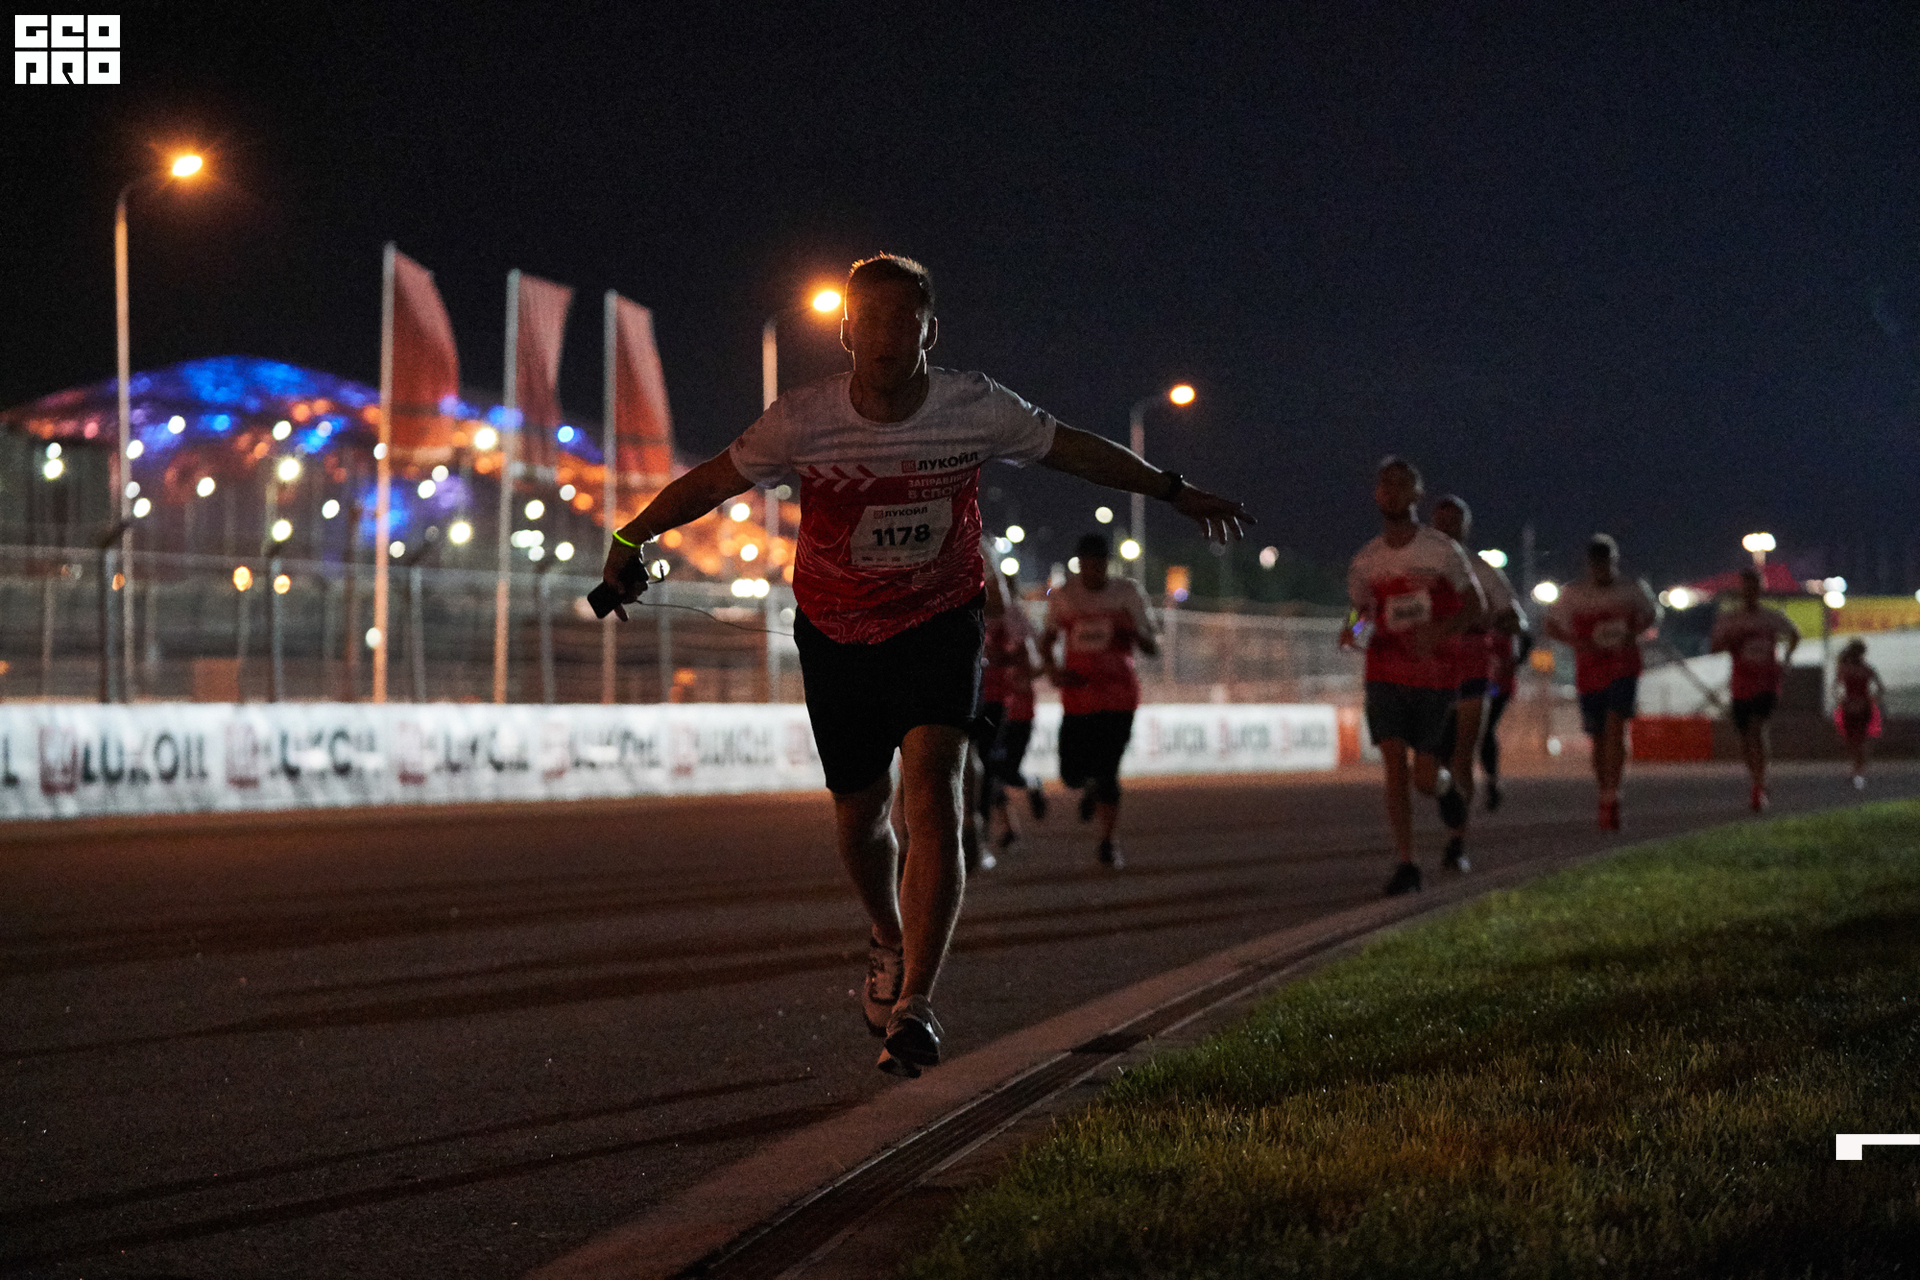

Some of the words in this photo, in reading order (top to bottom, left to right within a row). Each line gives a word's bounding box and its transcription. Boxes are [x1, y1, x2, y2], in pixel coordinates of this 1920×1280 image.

[917, 451, 978, 471] ЛУКОЙЛ
[885, 506, 928, 517] ЛУКОЙЛ
[872, 523, 931, 547] 1178
